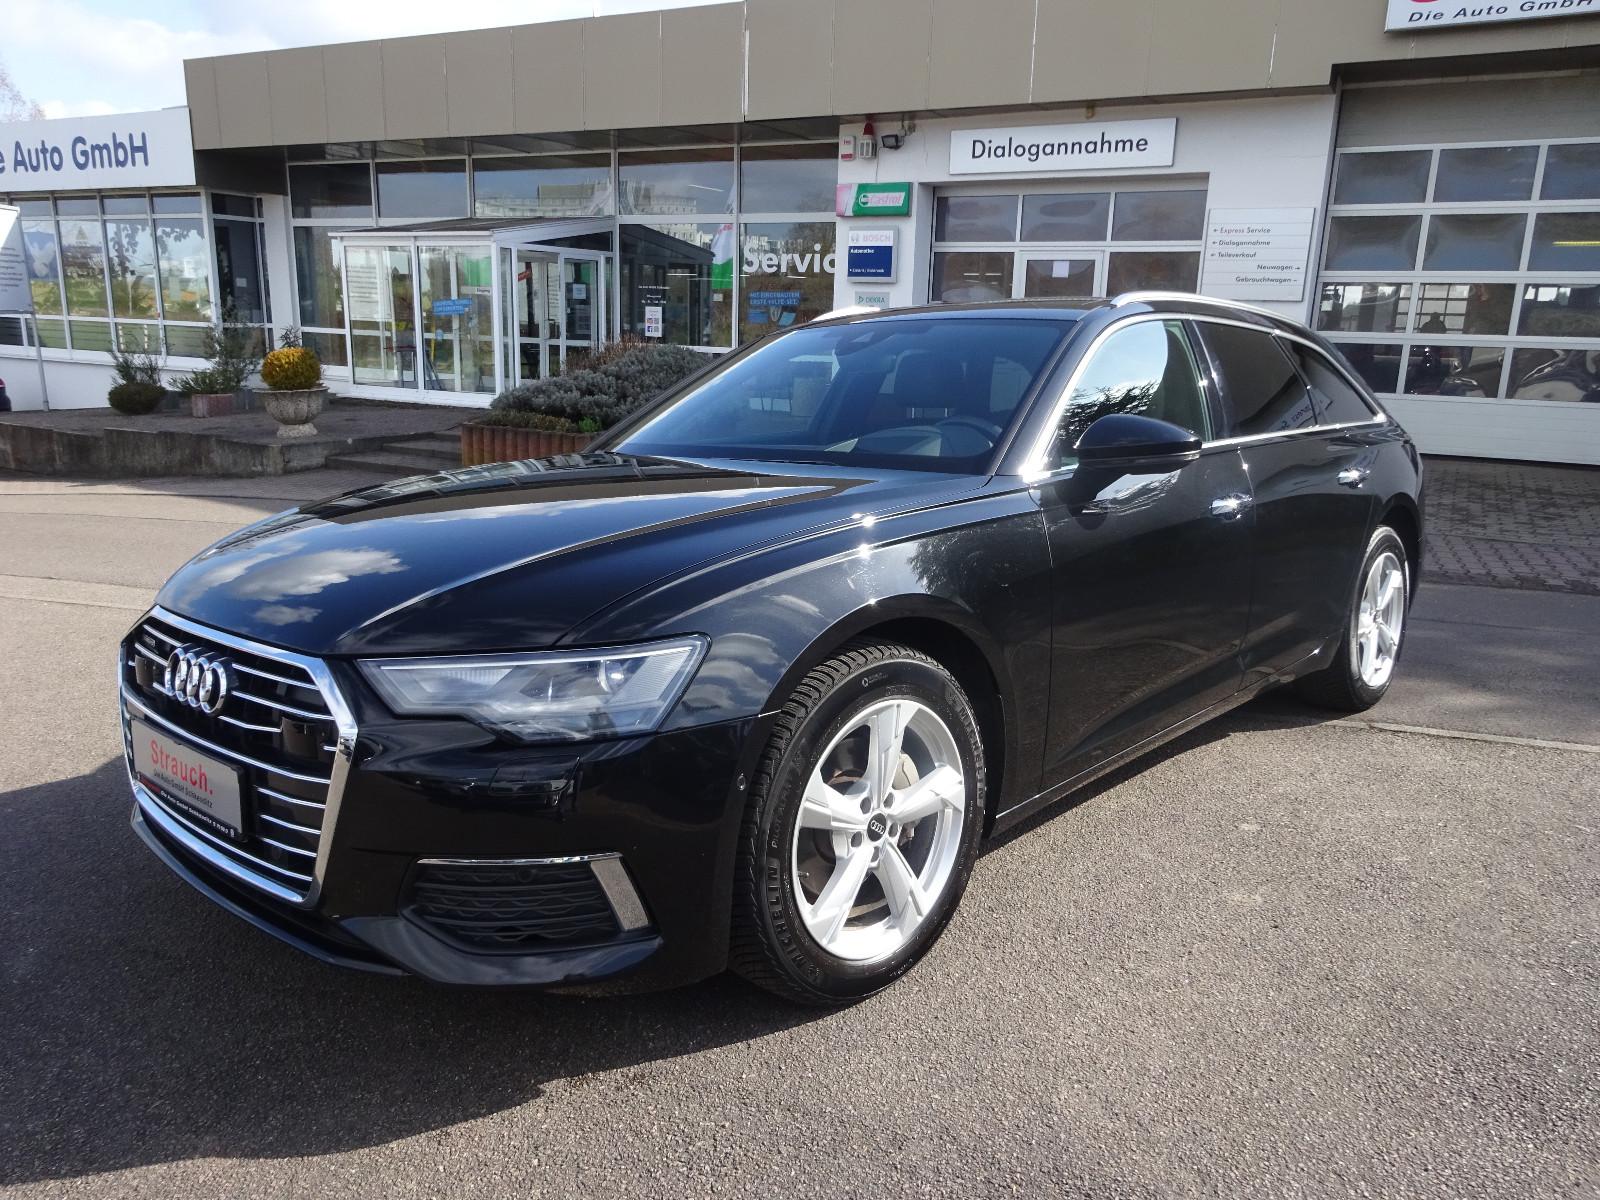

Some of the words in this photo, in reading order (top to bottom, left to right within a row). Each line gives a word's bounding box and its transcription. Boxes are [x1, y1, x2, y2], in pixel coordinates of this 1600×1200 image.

[1408, 11, 1444, 23] Die
[1453, 5, 1508, 19] Auto
[1519, 0, 1594, 12] GmbH
[13, 139, 64, 173] Auto
[71, 131, 149, 171] GmbH
[971, 131, 1149, 162] Dialogannahme
[863, 234, 891, 243] BOSCH
[1219, 227, 1245, 235] Express
[1246, 226, 1271, 234] Service
[1218, 239, 1271, 247] Dialogannahme
[1235, 276, 1292, 284] Gebrauchtwagen
[149, 739, 214, 796] Strauch.
